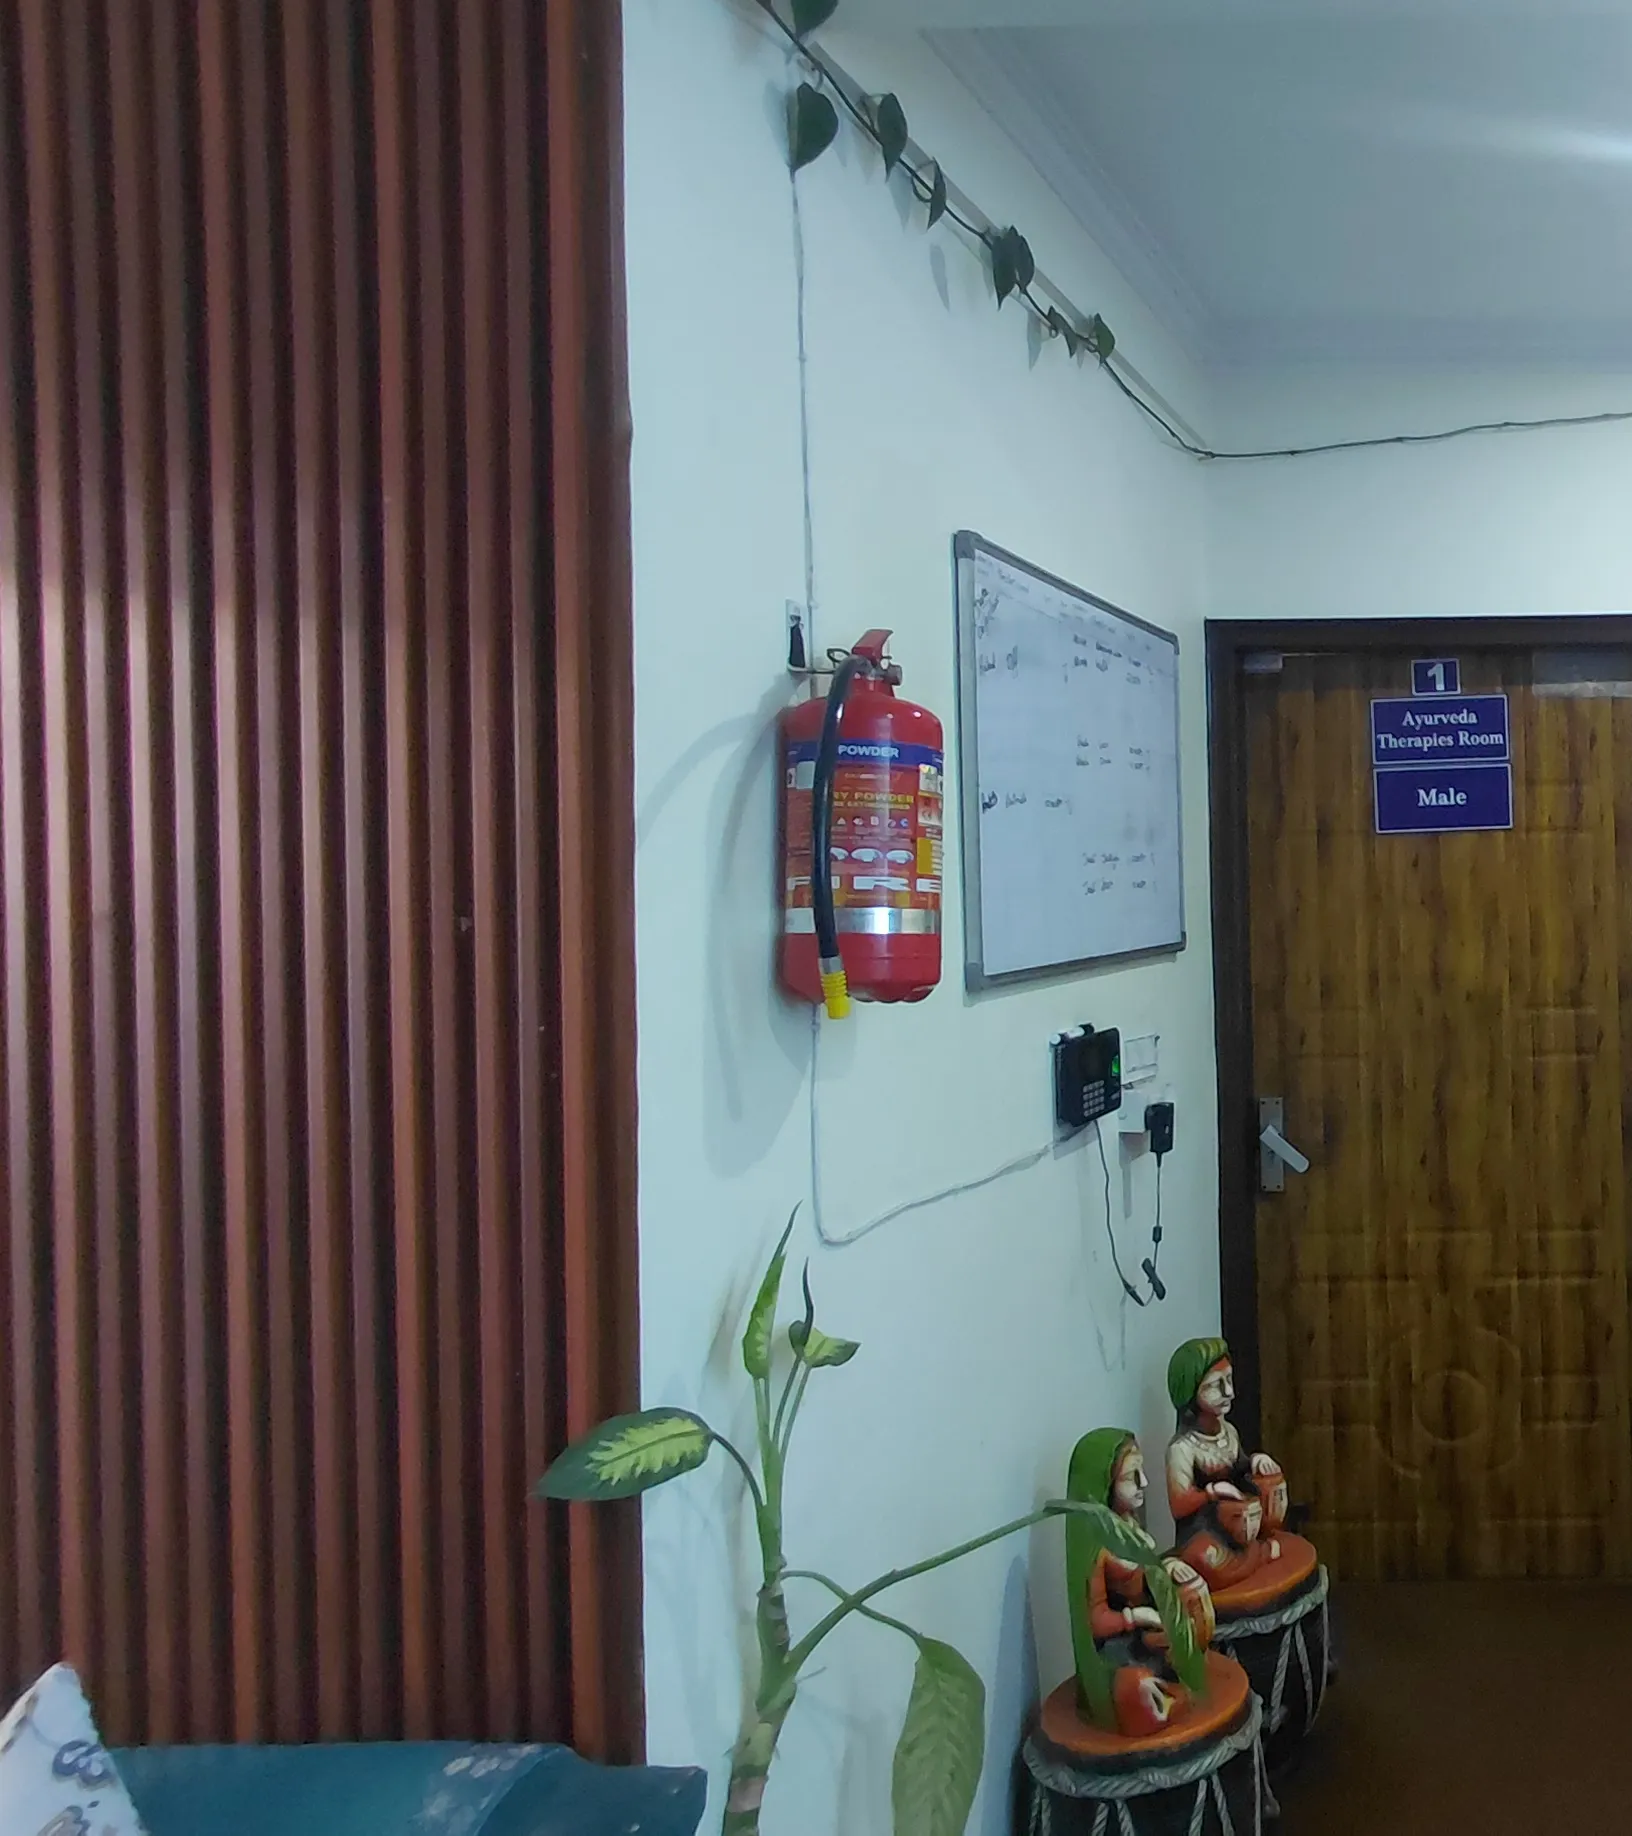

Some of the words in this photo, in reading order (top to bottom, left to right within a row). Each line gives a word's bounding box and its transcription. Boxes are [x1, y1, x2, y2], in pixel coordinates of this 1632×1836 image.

[1427, 663, 1445, 691] 1
[1402, 708, 1478, 731] Ayurveda
[838, 744, 899, 758] POWDER
[1377, 732, 1454, 752] Therapies
[1458, 730, 1505, 746] Room
[854, 792, 914, 804] POWDER
[1417, 787, 1467, 806] Male
